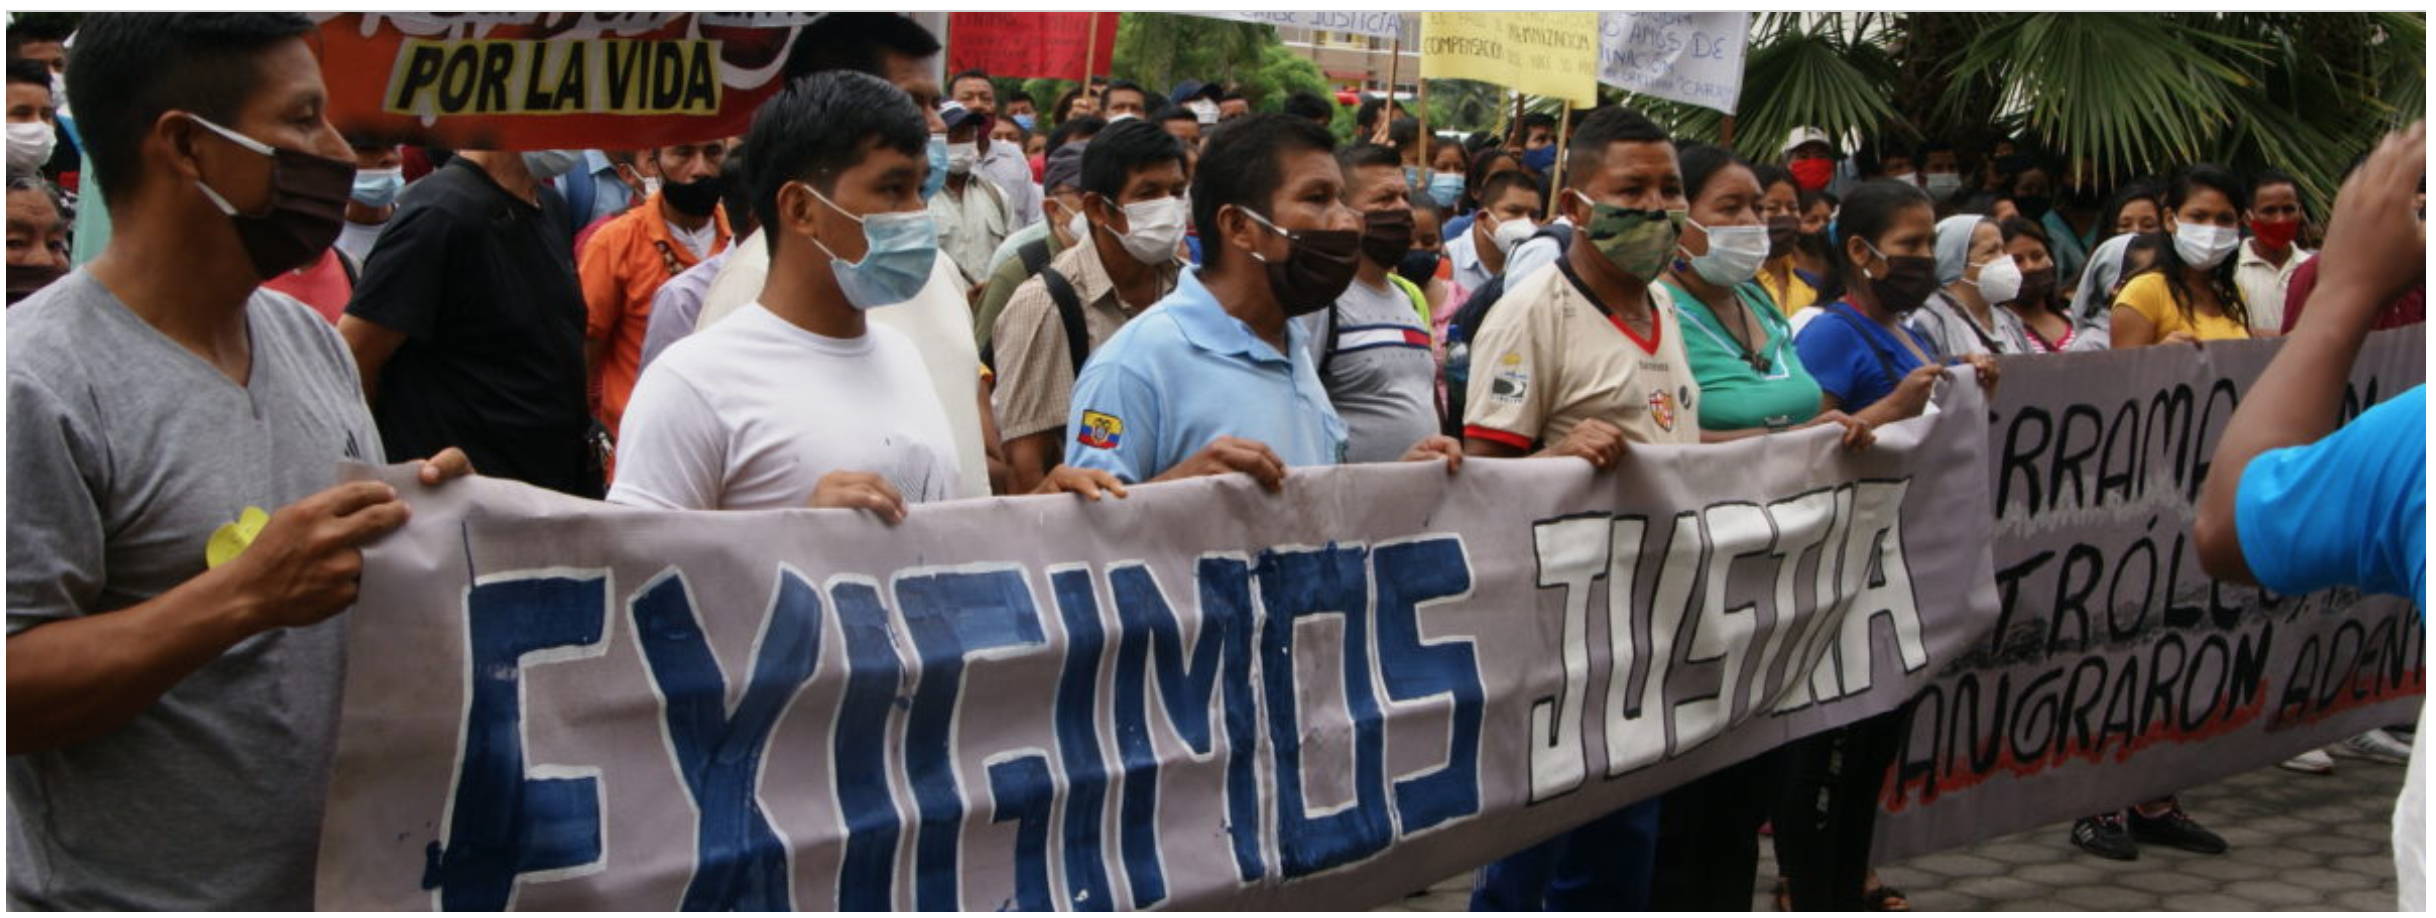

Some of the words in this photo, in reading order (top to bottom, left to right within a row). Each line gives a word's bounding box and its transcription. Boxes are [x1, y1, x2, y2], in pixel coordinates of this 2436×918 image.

[396, 42, 513, 113] POR
[524, 42, 586, 110] LA
[606, 42, 716, 110] VIDA
[1691, 31, 1726, 59] DE
[426, 532, 1488, 911] EXIGIMOS
[1527, 476, 1927, 806] JUSTIA
[1897, 622, 2273, 797] ANGRARON
